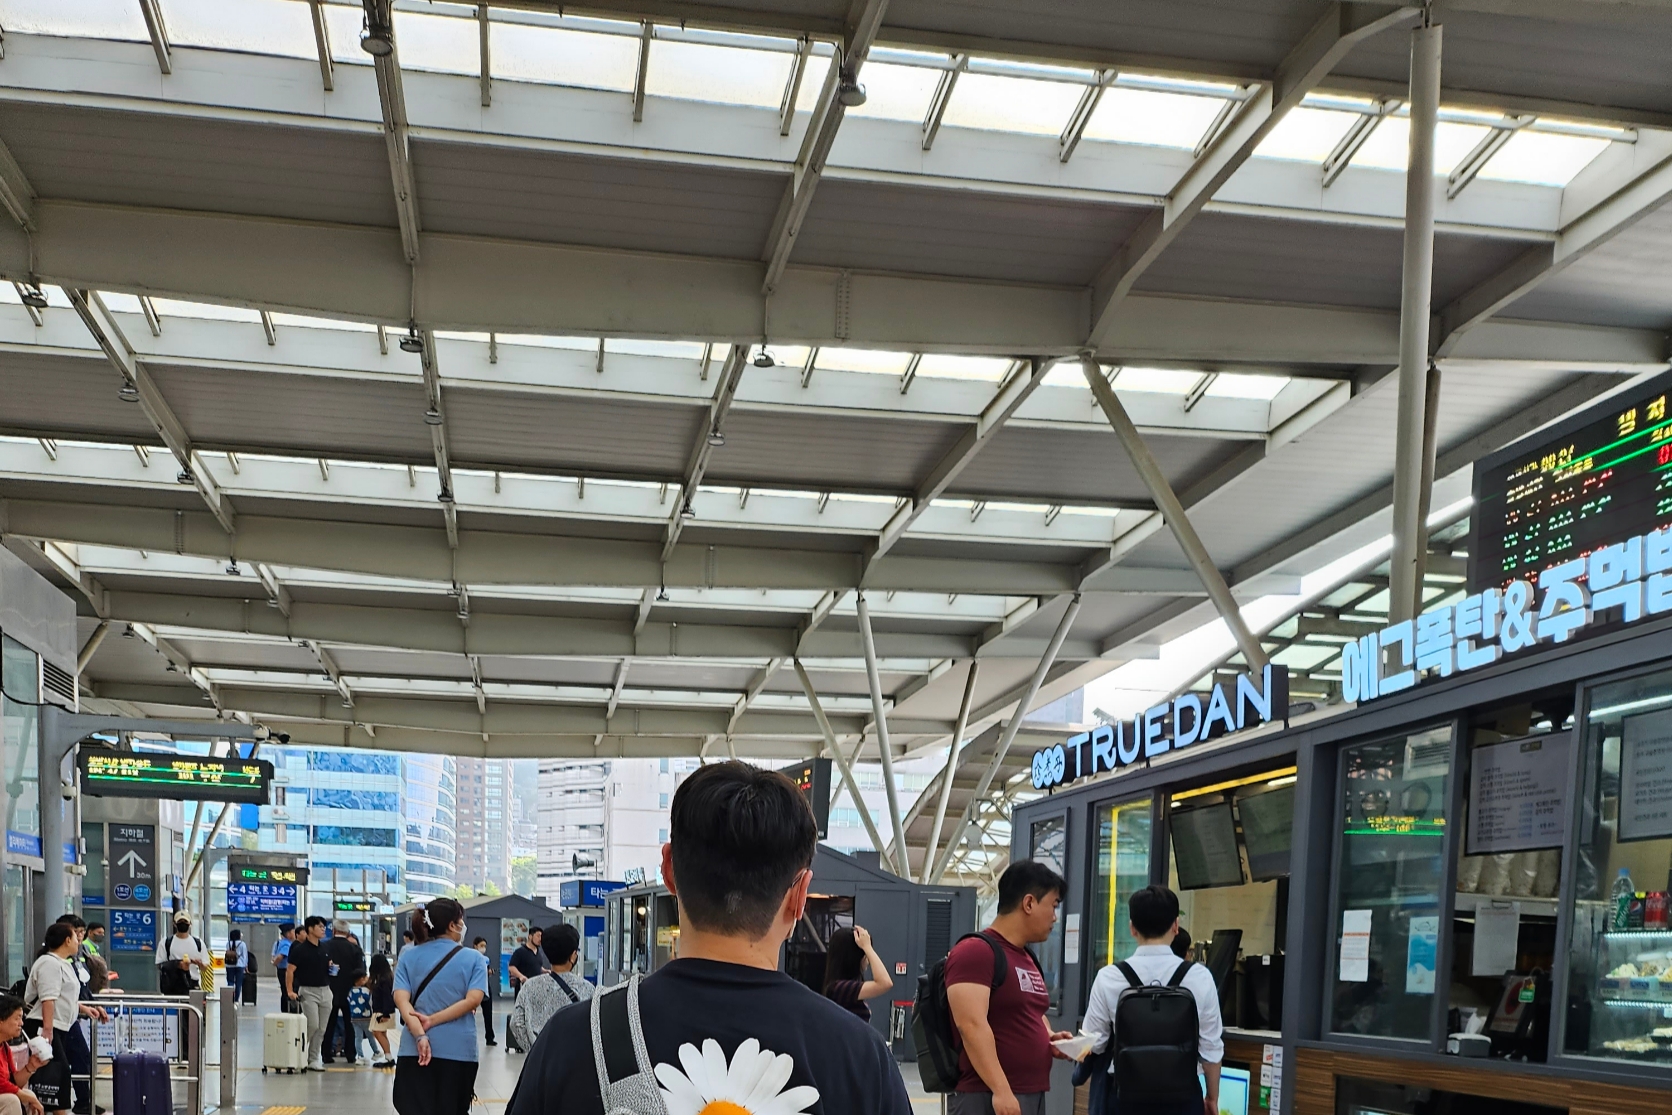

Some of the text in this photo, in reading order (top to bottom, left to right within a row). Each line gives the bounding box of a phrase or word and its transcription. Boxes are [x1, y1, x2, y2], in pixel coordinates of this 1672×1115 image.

[1066, 663, 1273, 779] TRUEDAN
[120, 828, 144, 838] 지하철
[239, 885, 246, 894] 4
[114, 912, 123, 924] 5
[142, 913, 152, 925] 6
